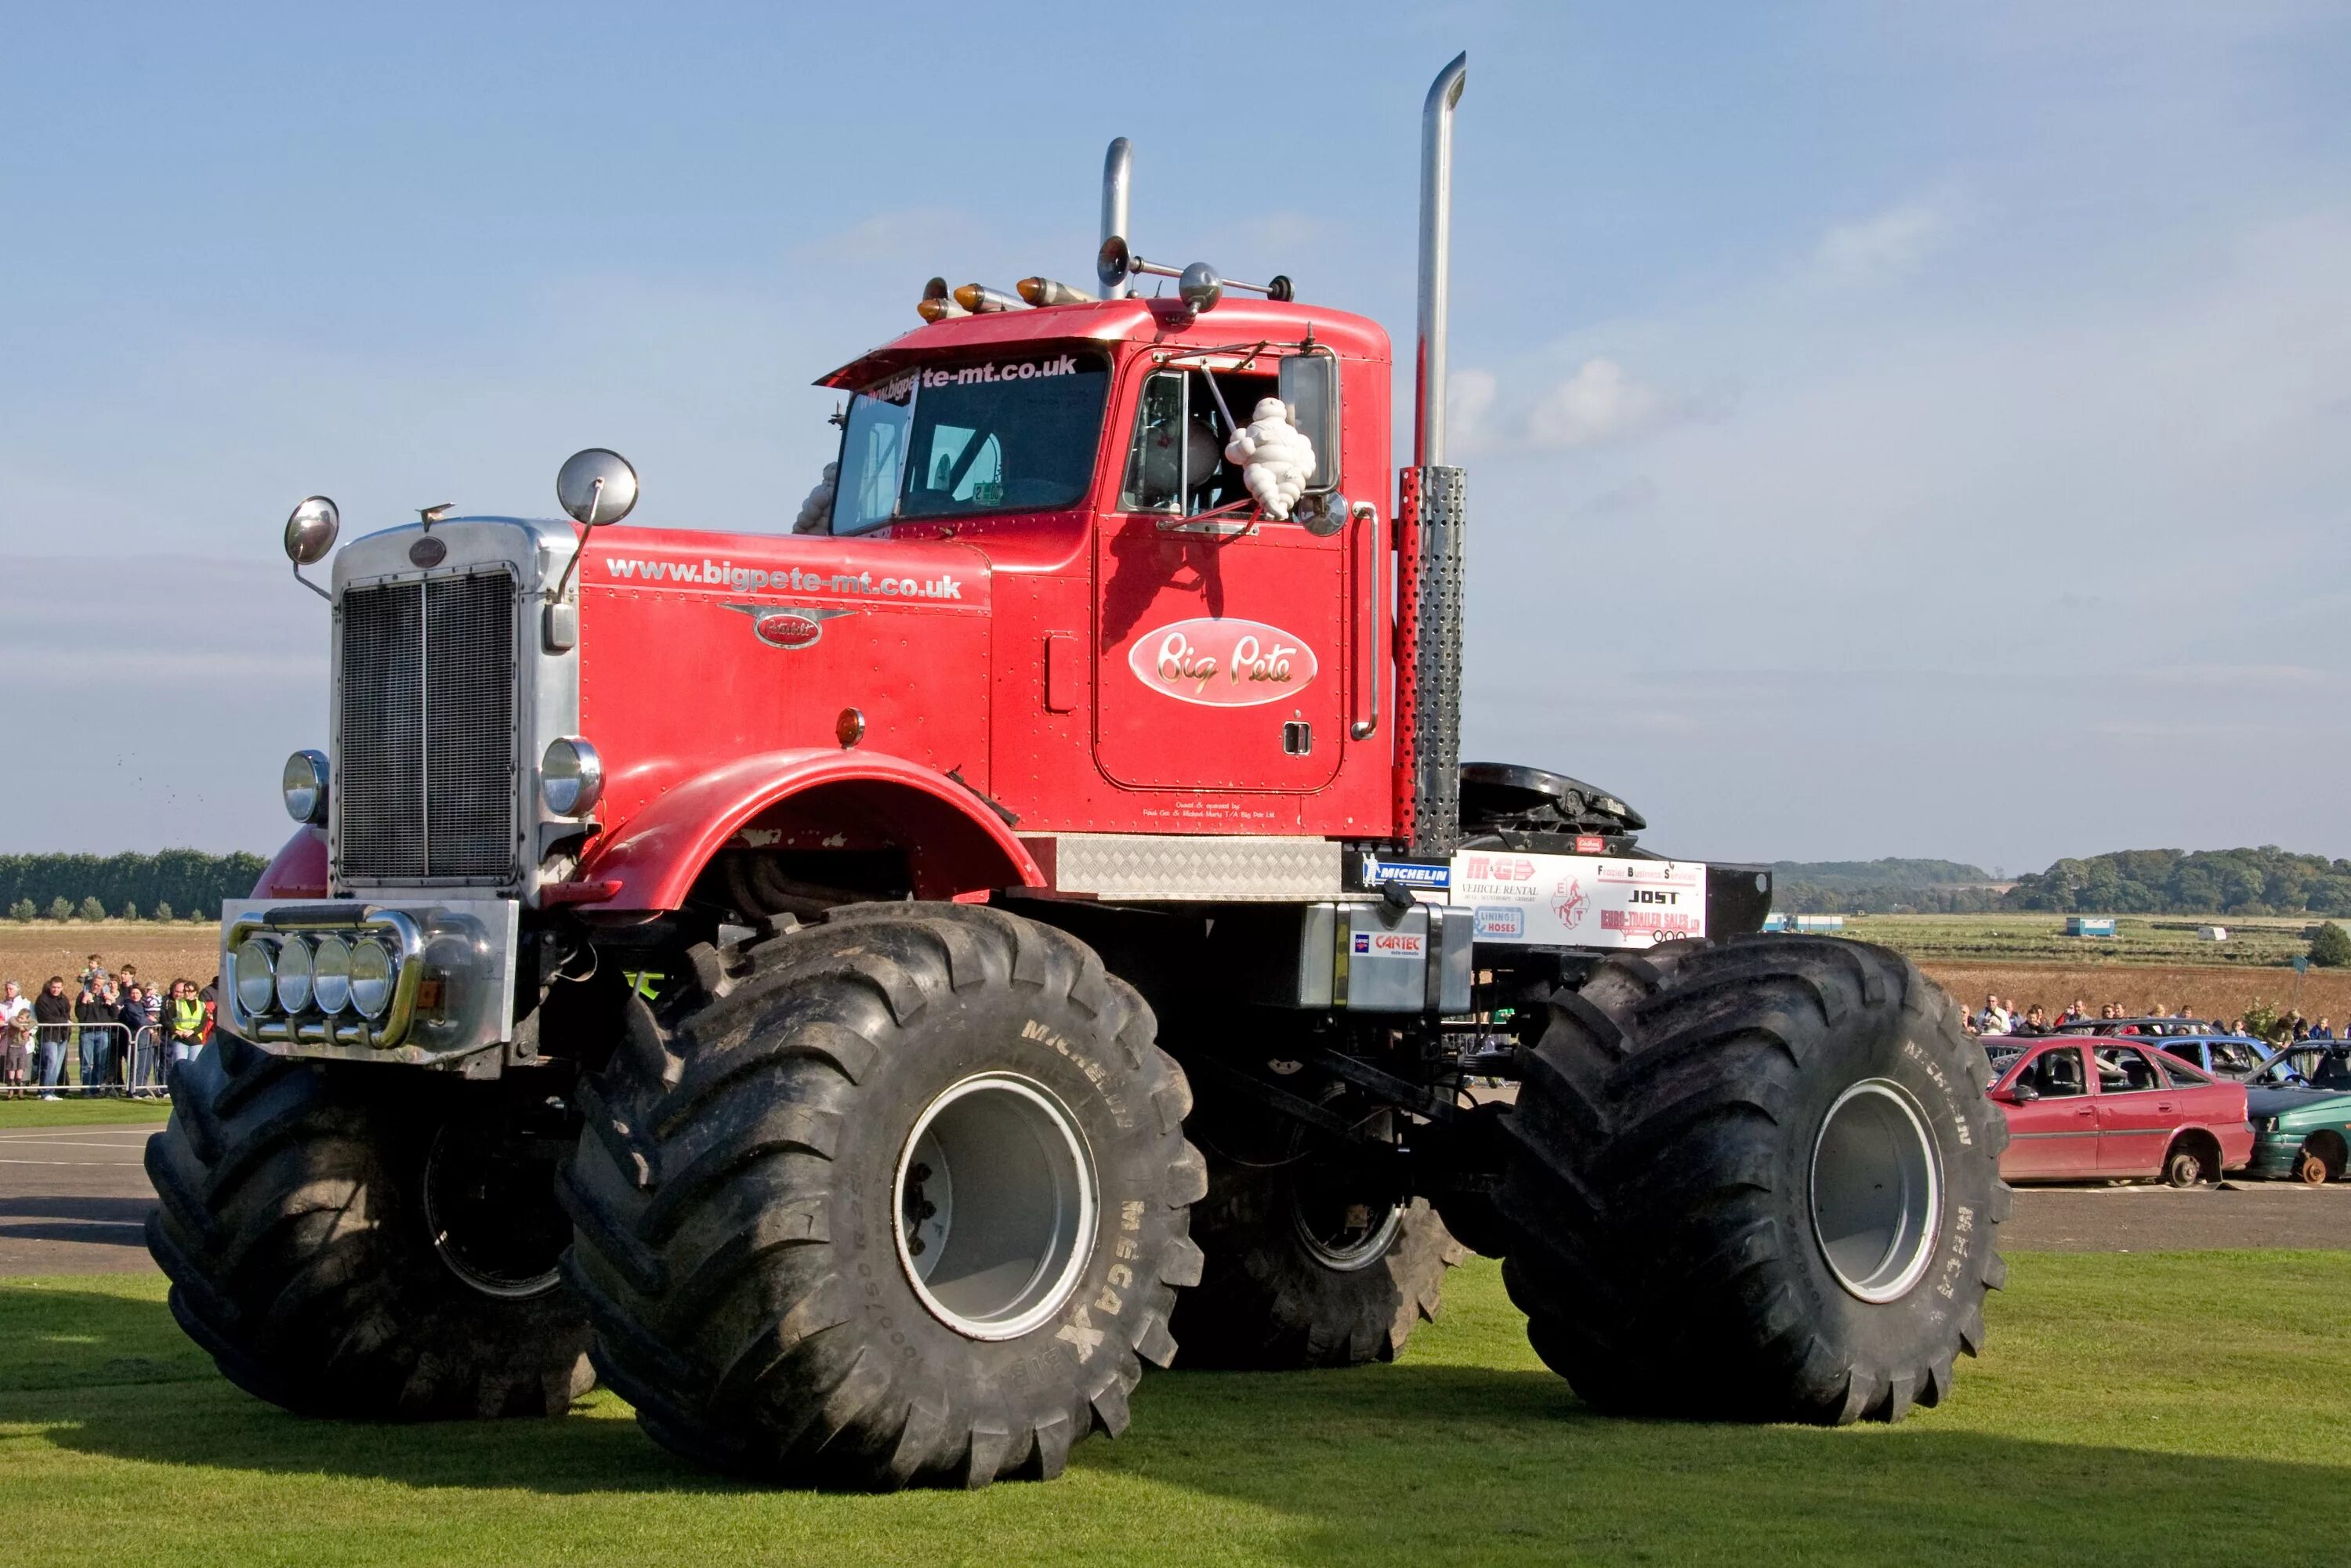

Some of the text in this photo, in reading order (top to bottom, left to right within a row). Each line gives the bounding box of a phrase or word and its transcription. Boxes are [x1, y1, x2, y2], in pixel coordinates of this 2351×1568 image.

[975, 486, 982, 500] 2
[607, 557, 962, 599] www.bigpete-mt.co.uk
[1157, 632, 1297, 694] Big Pete
[1381, 867, 1447, 882] MICHELIN
[1628, 867, 1661, 878] Business
[1664, 869, 1696, 882] Services
[1462, 883, 1539, 896] VEHICLE RENTAL
[1557, 882, 1565, 893] E
[1628, 890, 1680, 905] JOST
[1480, 912, 1515, 922] LININGS
[1576, 910, 1583, 922] T
[1601, 910, 1661, 928] EURO-TRAILER
[1664, 913, 1689, 929] SALES
[1488, 923, 1516, 932] HOSES
[1375, 935, 1422, 951] CARTEC
